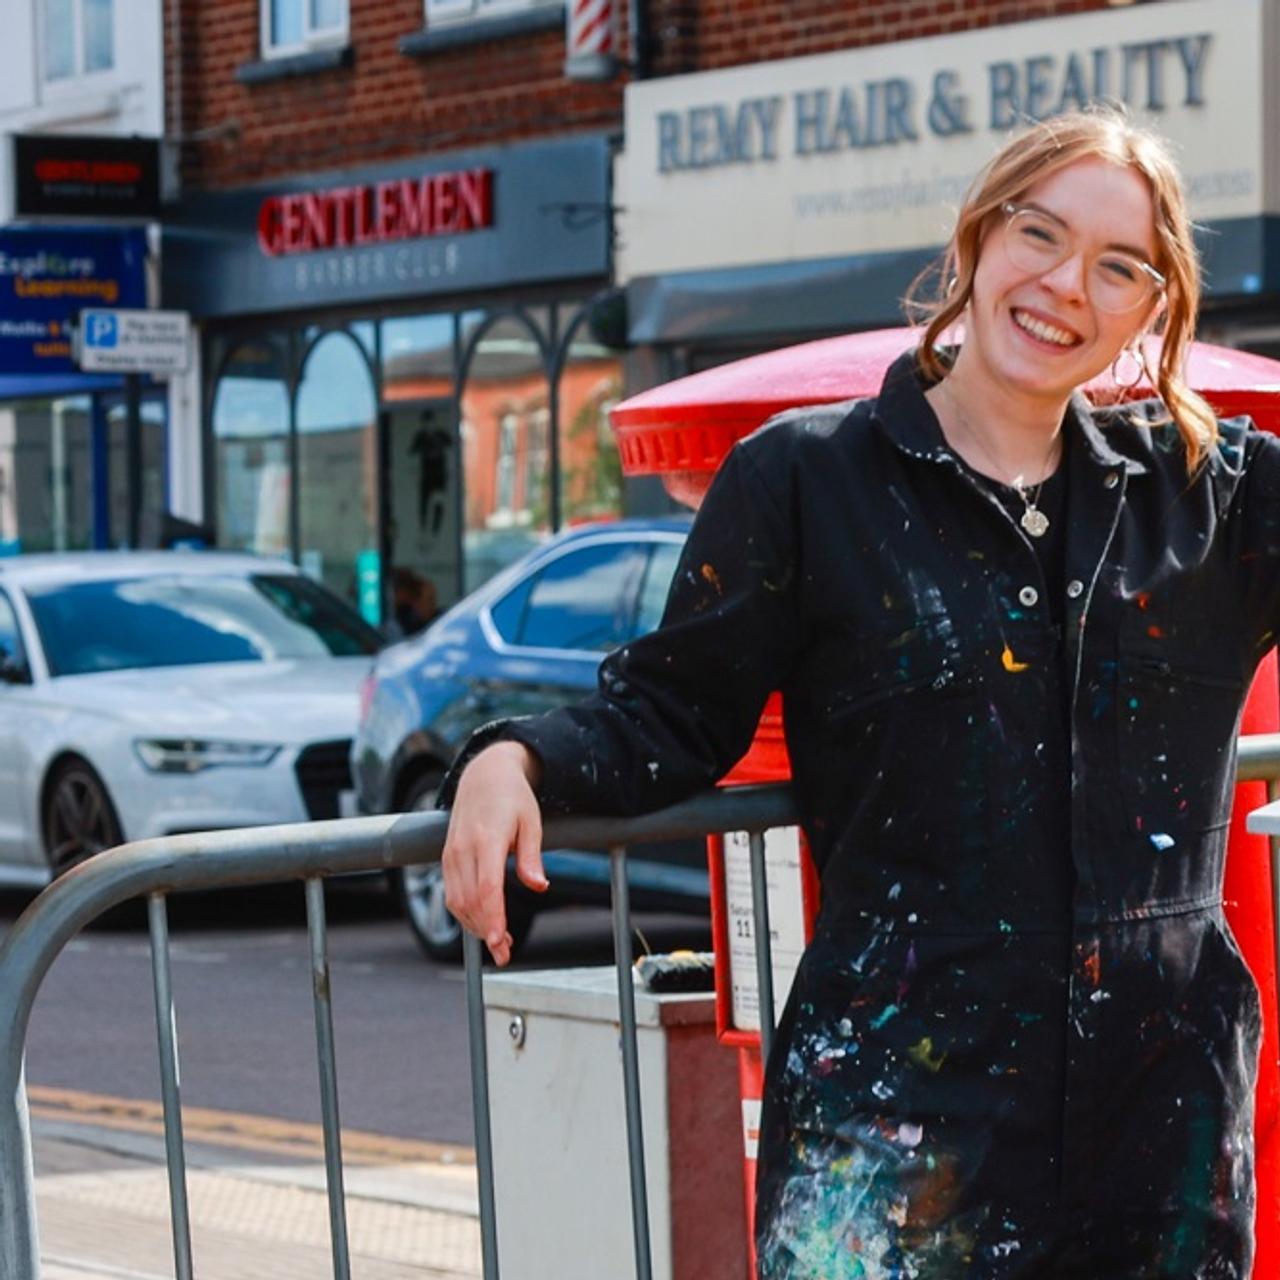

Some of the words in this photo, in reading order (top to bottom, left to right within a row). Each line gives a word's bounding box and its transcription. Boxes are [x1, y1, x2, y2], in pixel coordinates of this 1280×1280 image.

[656, 94, 784, 175] REMY
[794, 76, 919, 156] HAIR
[926, 69, 974, 138] &
[988, 33, 1213, 130] BEAUTY
[257, 166, 494, 257] GENTLEMEN
[14, 272, 119, 303] Learning
